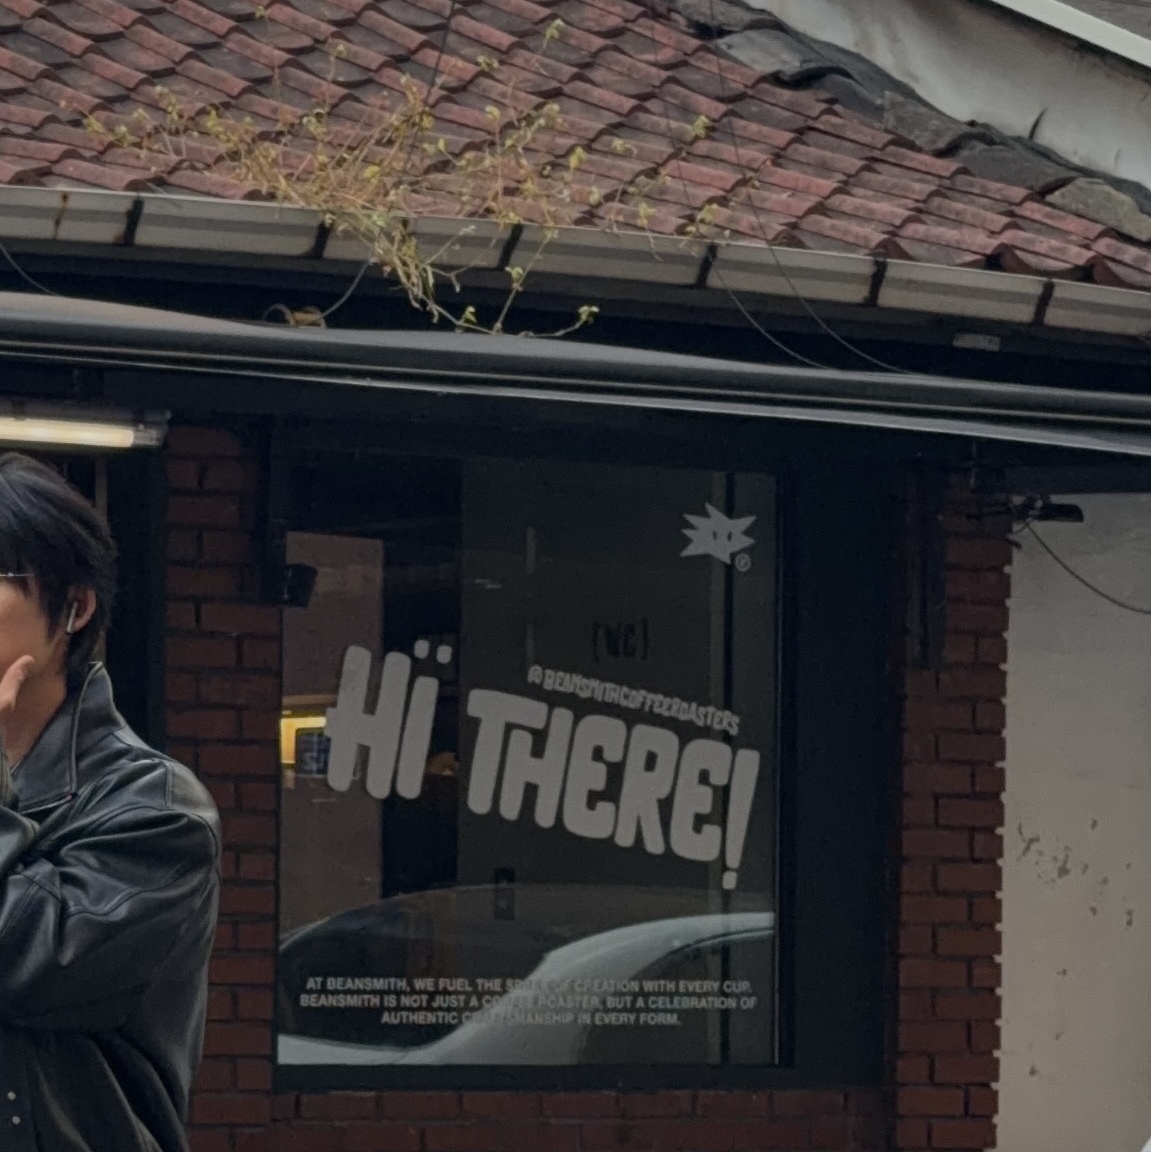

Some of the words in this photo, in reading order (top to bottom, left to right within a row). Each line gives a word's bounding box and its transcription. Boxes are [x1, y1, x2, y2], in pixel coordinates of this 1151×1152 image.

[466, 688, 761, 891] THERE!
[305, 977, 325, 991] AT
[414, 978, 436, 992] WE
[438, 978, 473, 992] FUEL
[476, 978, 503, 993] THE
[506, 978, 548, 992] SPK
[642, 980, 676, 993] WITH
[678, 980, 721, 994] EVERY
[299, 994, 381, 1008] BEANSMITH
[383, 994, 398, 1008] IS
[400, 994, 431, 1008] NOT
[431, 994, 466, 1009] JUST
[468, 995, 480, 1008] A
[482, 995, 535, 1009] COEE
[606, 996, 633, 1009] BUT
[635, 996, 645, 1009] A
[647, 996, 739, 1009] CELEBRATION
[739, 997, 757, 1010] OF
[381, 1011, 459, 1025] AUTHENTIC
[594, 1012, 638, 1025] EVERY
